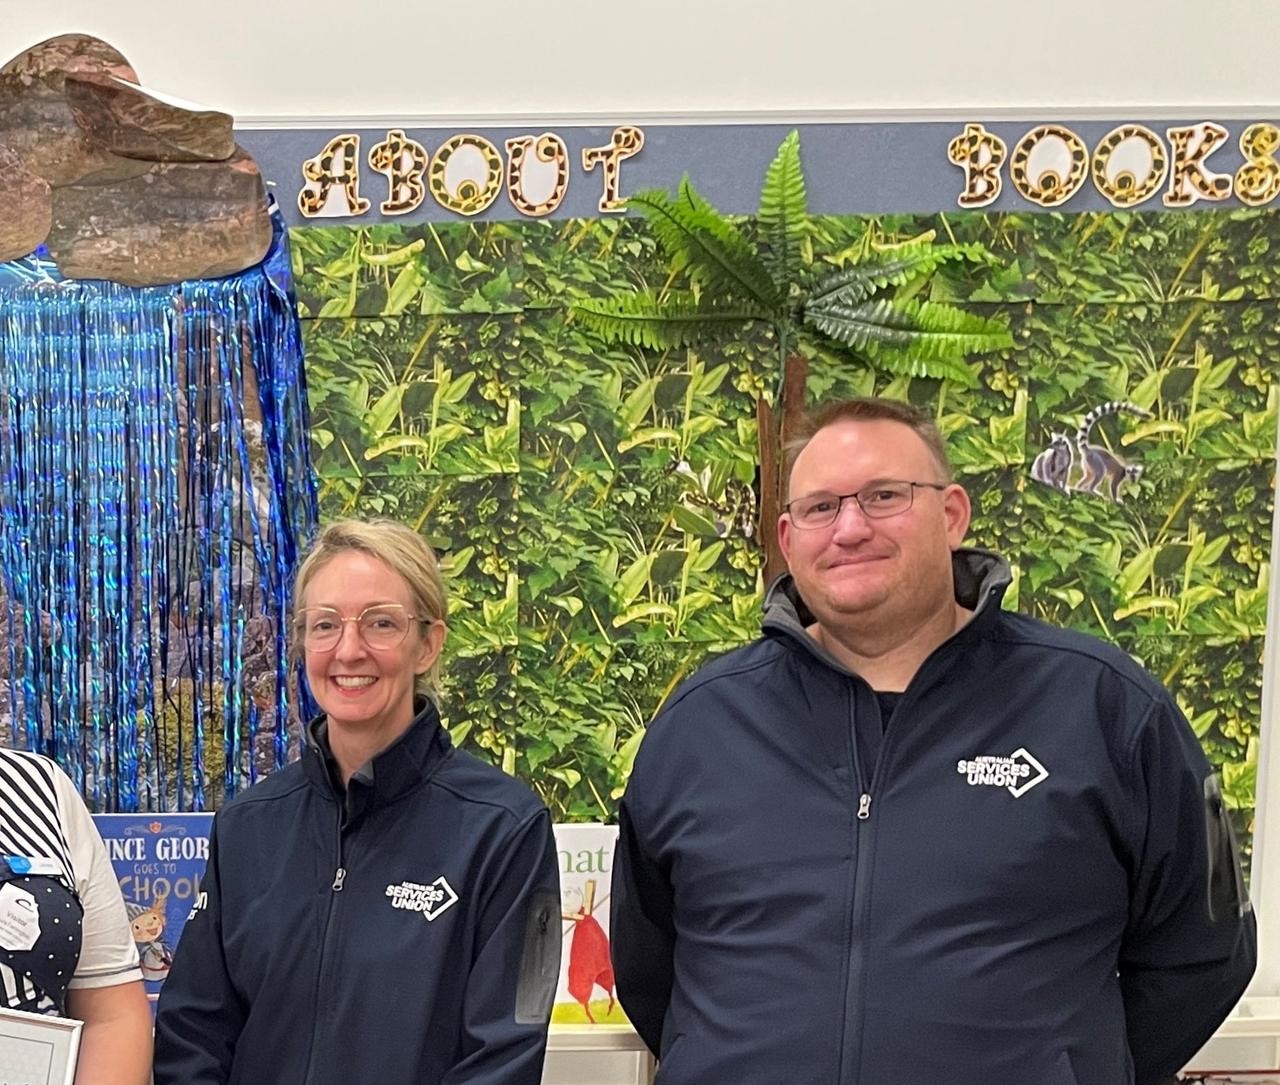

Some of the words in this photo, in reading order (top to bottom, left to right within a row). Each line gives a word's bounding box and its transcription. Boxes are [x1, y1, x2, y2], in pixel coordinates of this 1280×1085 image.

[297, 125, 646, 219] ABOUT
[949, 121, 1280, 209] BOOKS
[957, 759, 1030, 778] SERVICES
[967, 772, 1018, 787] UNION
[103, 837, 147, 861] INCE
[155, 836, 210, 862] GEOR
[133, 863, 160, 875] GOES
[162, 863, 177, 874] TO
[119, 873, 200, 902] CHOO
[385, 884, 444, 902] SERVICES
[391, 896, 434, 911] UNION
